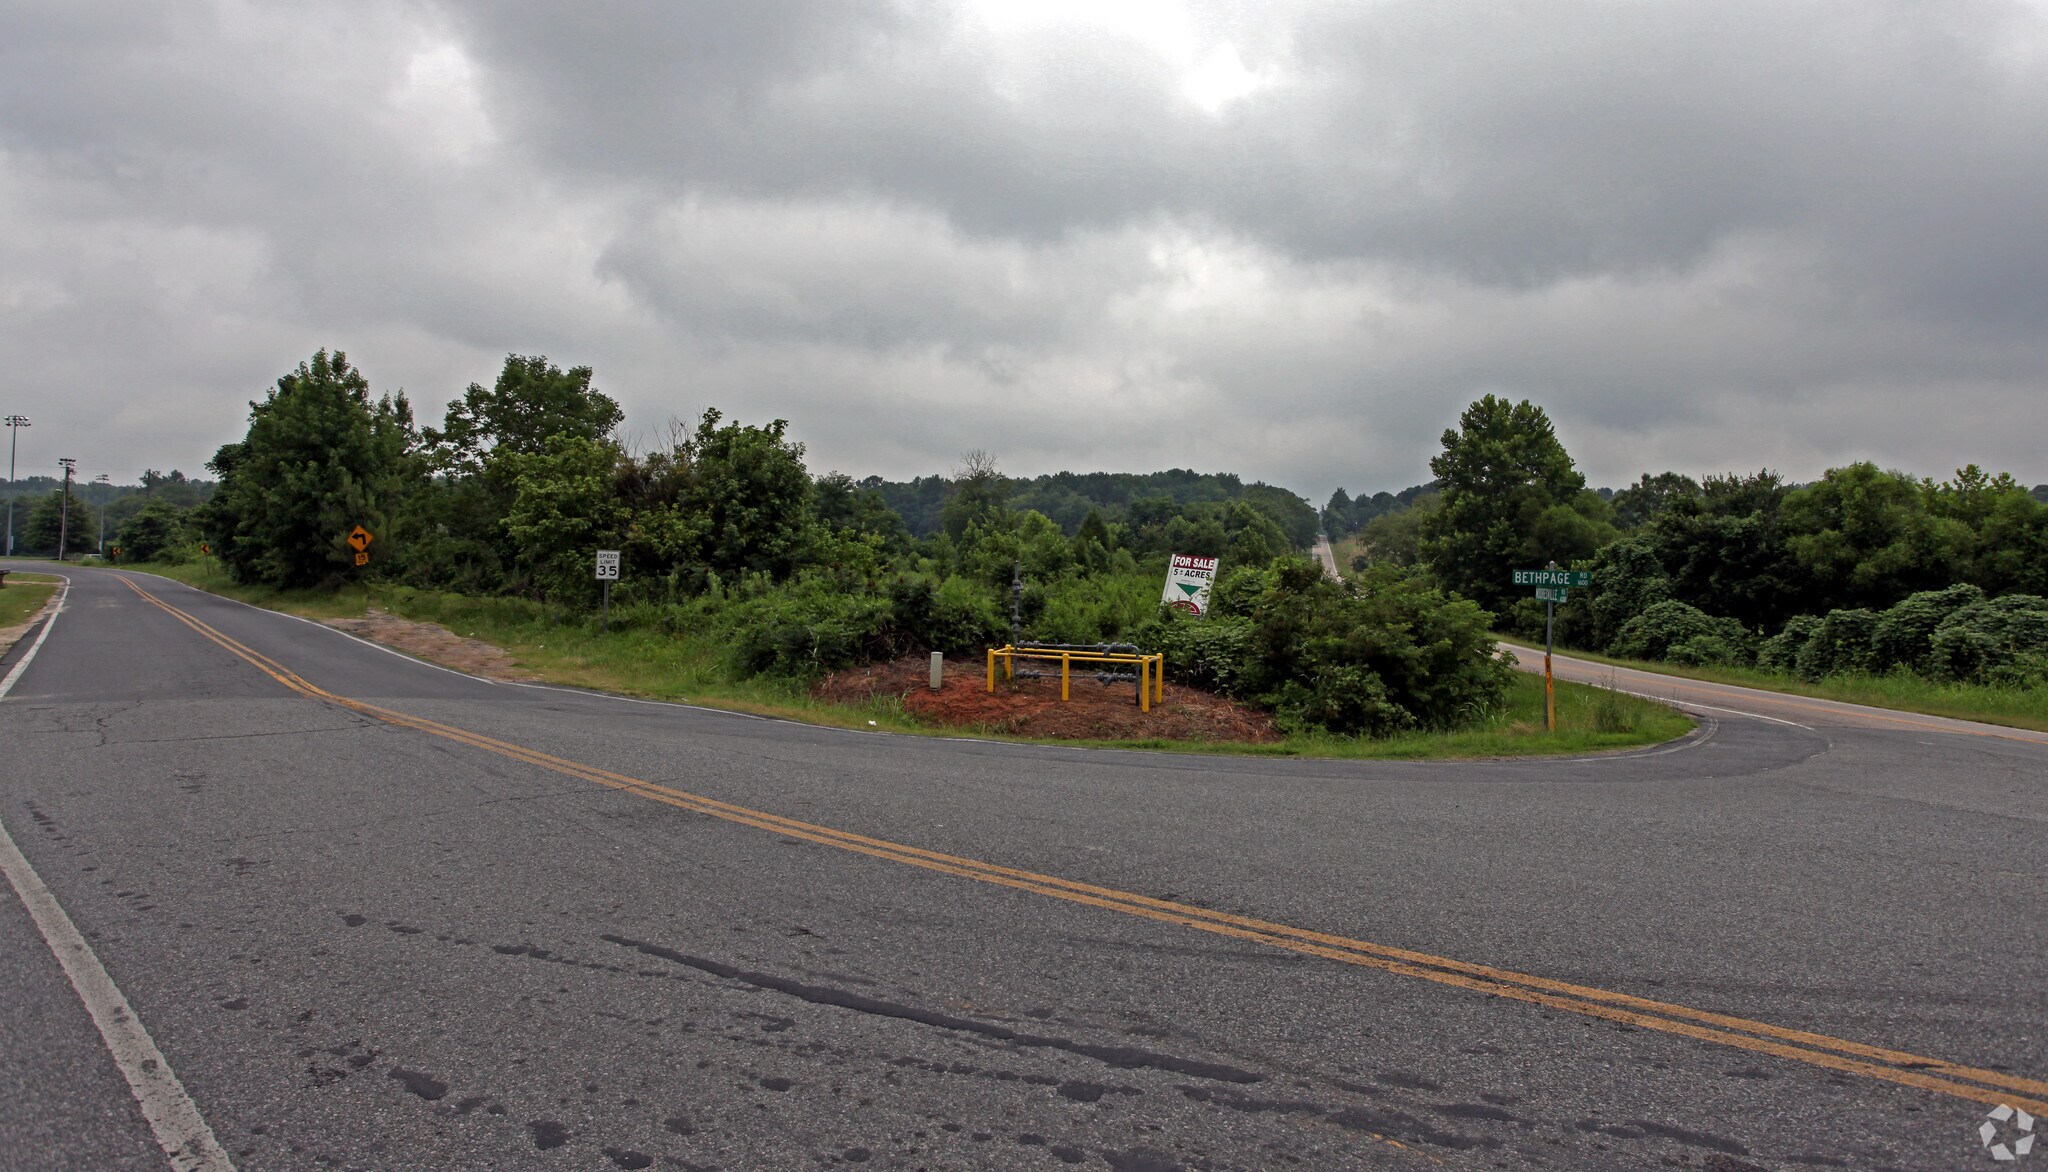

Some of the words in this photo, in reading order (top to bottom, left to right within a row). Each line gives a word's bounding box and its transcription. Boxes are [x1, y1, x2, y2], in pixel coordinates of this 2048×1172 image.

[1174, 556, 1191, 567] FOR
[1193, 558, 1215, 569] SALE
[598, 566, 617, 576] 35
[1184, 570, 1210, 578] ACRES
[1515, 571, 1570, 584] BETHPAGE
